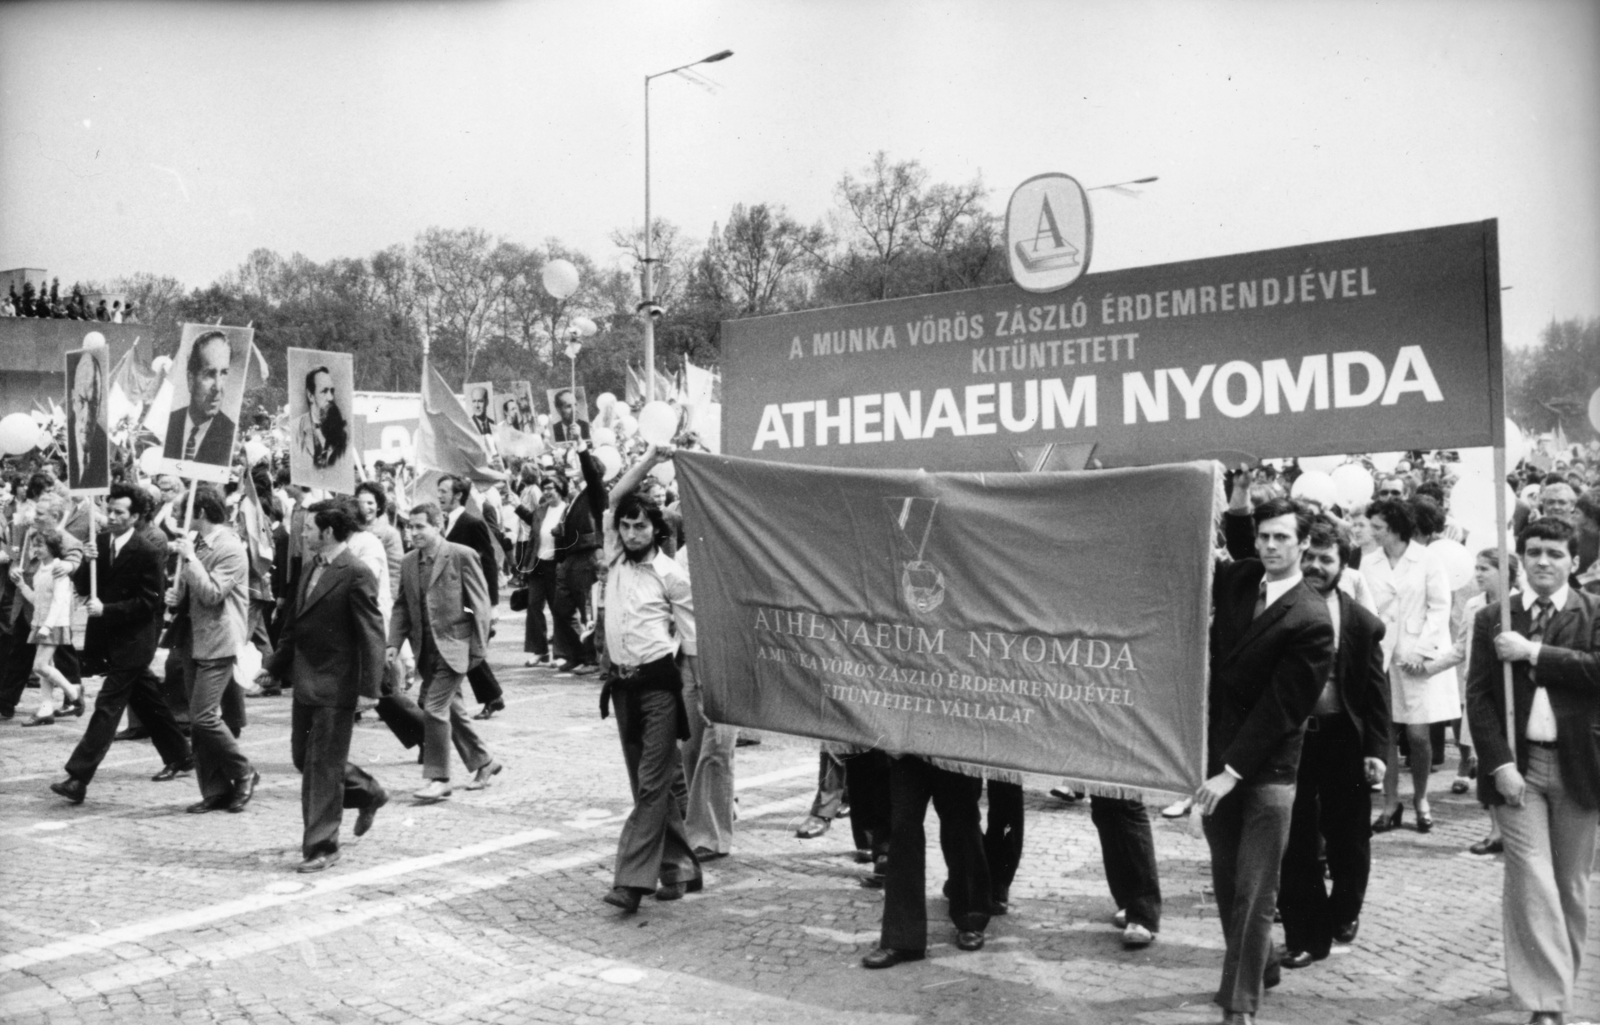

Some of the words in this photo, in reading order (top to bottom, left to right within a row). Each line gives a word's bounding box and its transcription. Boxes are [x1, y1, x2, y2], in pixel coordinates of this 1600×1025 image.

[789, 336, 803, 360] A
[813, 325, 897, 356] MUNKA
[907, 311, 984, 346] VÖRÖS
[996, 296, 1088, 337] ZÁSZLÓ
[1102, 267, 1377, 325] ÉRDEMRENDJÉVEL
[972, 333, 1139, 374] KITÜNTETETT
[751, 375, 1097, 450] ATHENAEUM
[1122, 344, 1445, 425] NYOMDA
[754, 607, 946, 655] ATHENAEUM
[968, 631, 1137, 671] NYOMDA
[757, 646, 767, 660] A
[820, 654, 874, 678] VÖRÖS
[878, 664, 943, 689] ZÁSZLÓ
[948, 671, 1134, 707] ÉRDEMRENDJÉVEL
[941, 698, 1034, 724] VÁLLALAT
